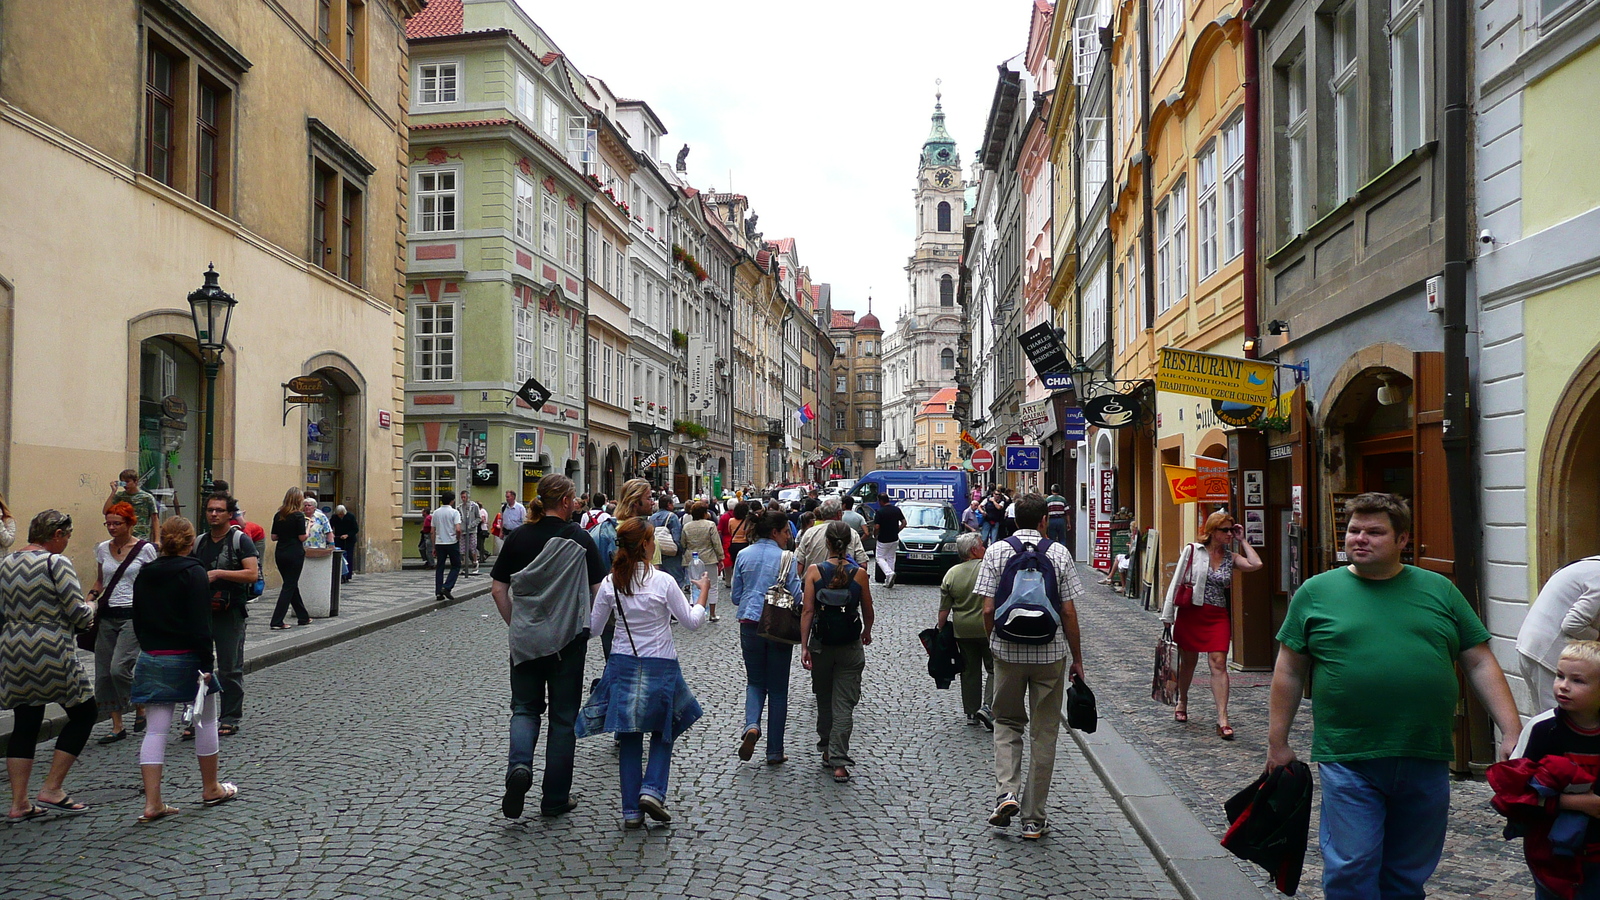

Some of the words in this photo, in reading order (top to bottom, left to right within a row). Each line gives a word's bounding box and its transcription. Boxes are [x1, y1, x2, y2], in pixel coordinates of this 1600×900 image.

[1026, 334, 1051, 351] CHARLES
[1032, 342, 1053, 356] BRIDGE
[1031, 347, 1060, 365] RESIDENCE
[1161, 350, 1244, 379] RESTAURANT
[1160, 372, 1240, 388] AIR-CONDITIONED
[1159, 380, 1209, 395] TRADITIONAL
[1210, 388, 1237, 400] CZECH
[1236, 392, 1268, 404] CUISINE
[1022, 404, 1037, 415] ART
[1022, 410, 1047, 421] GALERIE
[1246, 406, 1263, 422] BOTY
[524, 469, 543, 477] CHANGE
[1103, 471, 1111, 512] CHANGE
